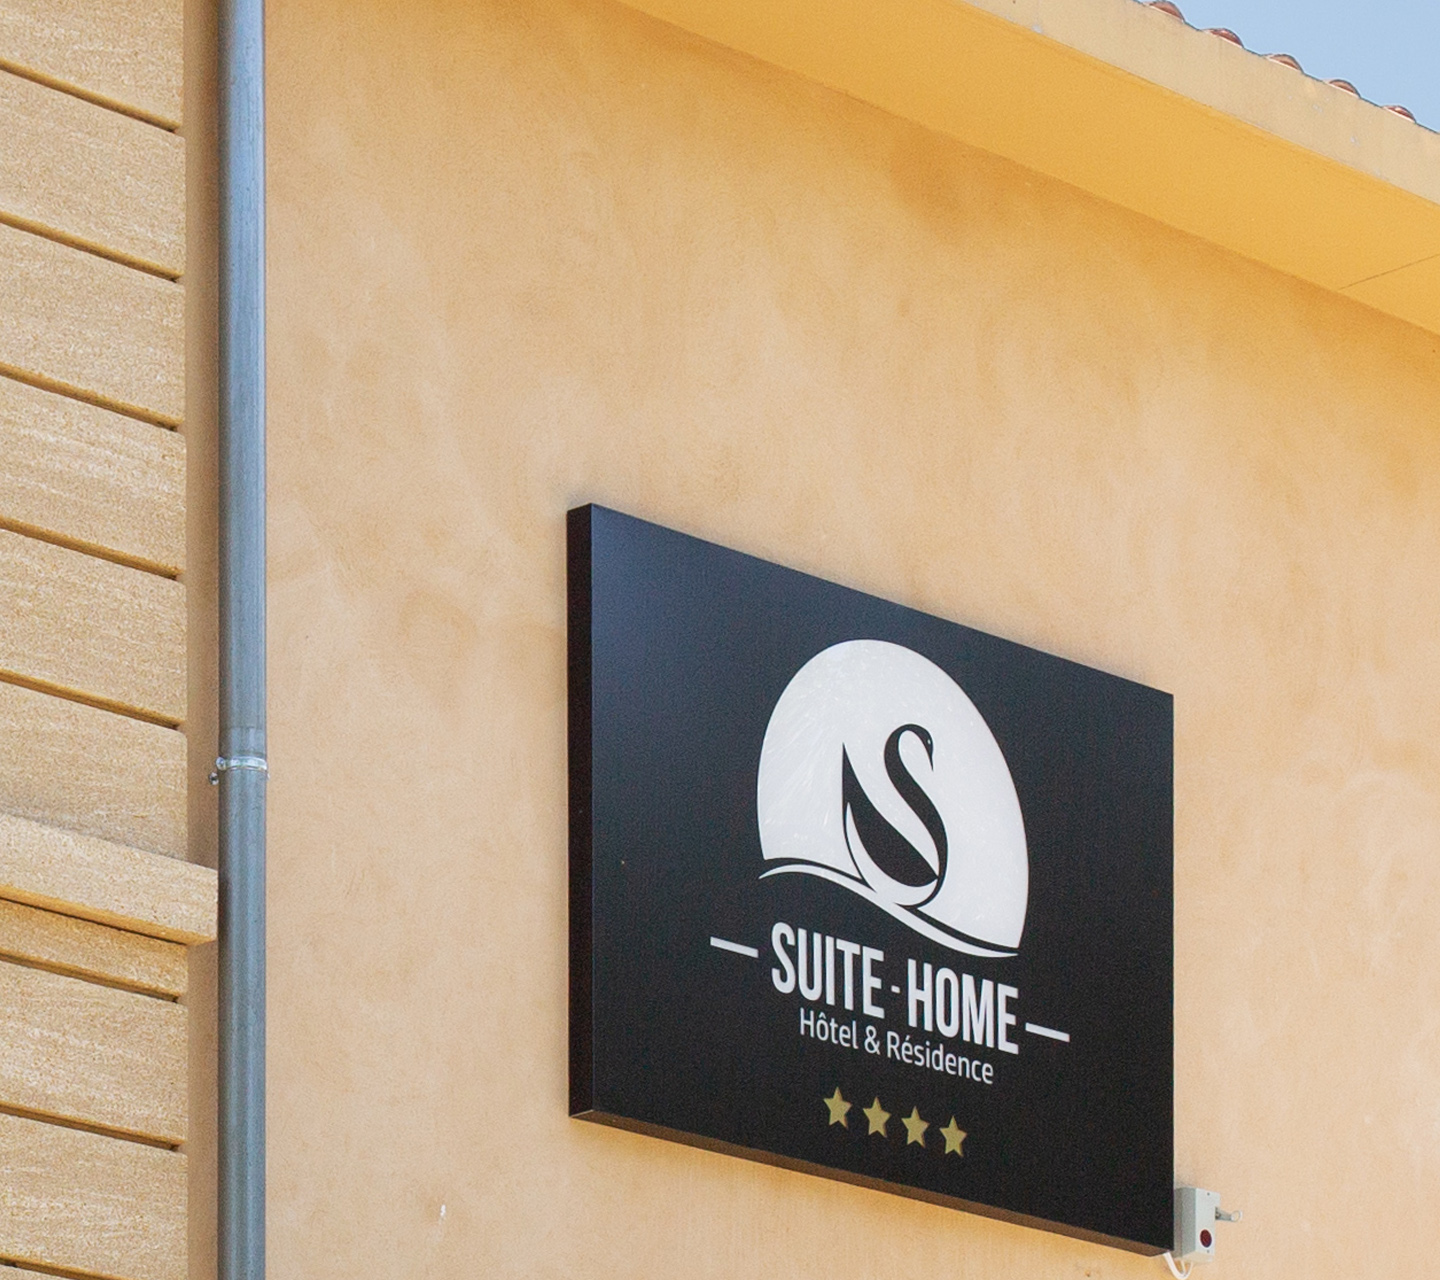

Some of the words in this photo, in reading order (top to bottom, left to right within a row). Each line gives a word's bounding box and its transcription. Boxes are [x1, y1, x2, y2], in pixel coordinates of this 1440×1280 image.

[771, 922, 885, 1019] SUITE
[907, 958, 1019, 1055] HOME
[799, 1007, 859, 1050] Hôtel
[864, 1025, 881, 1055] &
[886, 1031, 994, 1085] Résidence
